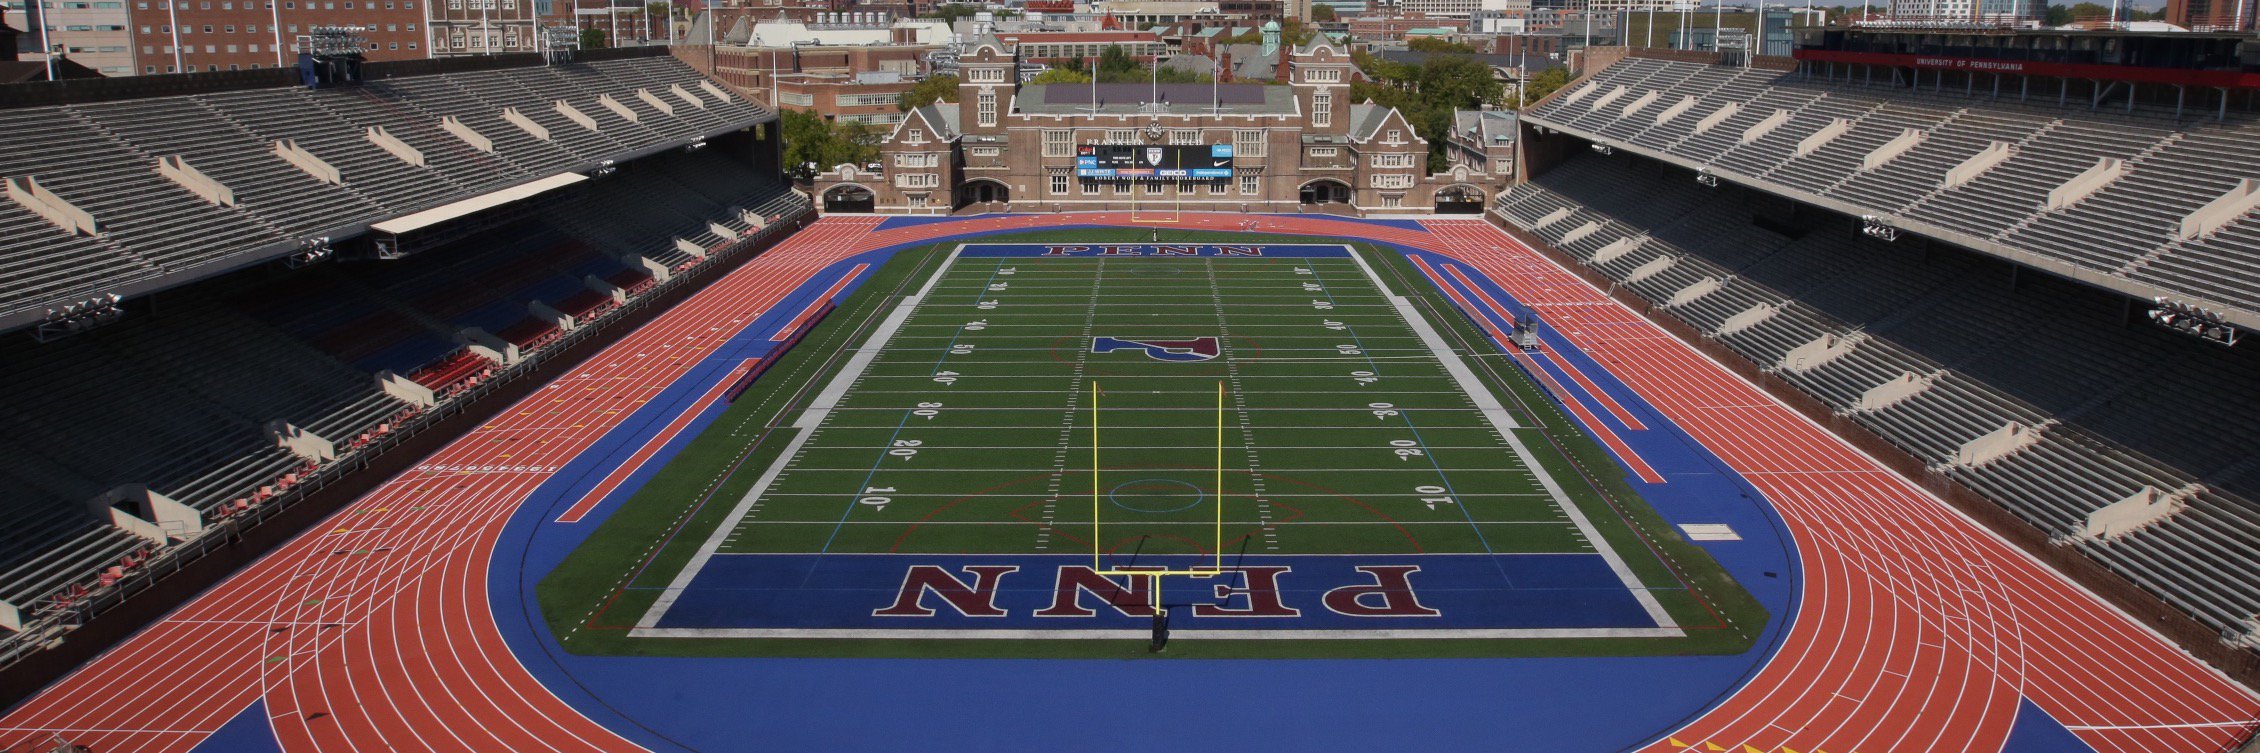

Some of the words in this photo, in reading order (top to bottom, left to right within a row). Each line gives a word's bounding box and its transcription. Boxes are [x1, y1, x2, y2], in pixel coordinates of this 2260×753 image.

[1917, 58, 1953, 66] UNIVERSITY
[1970, 61, 2023, 70] PENNSYLVANIA
[1041, 245, 1267, 256] PENN
[950, 344, 975, 354] 50
[1336, 344, 1362, 354] 50
[932, 370, 960, 382] 40
[1350, 371, 1379, 382] 40
[913, 402, 943, 415] 30
[1368, 402, 1399, 416] 30
[889, 439, 923, 456] 20
[1389, 439, 1424, 456] 20
[860, 486, 896, 505] 10
[1415, 486, 1454, 504] 10
[871, 565, 1441, 617] PENN
